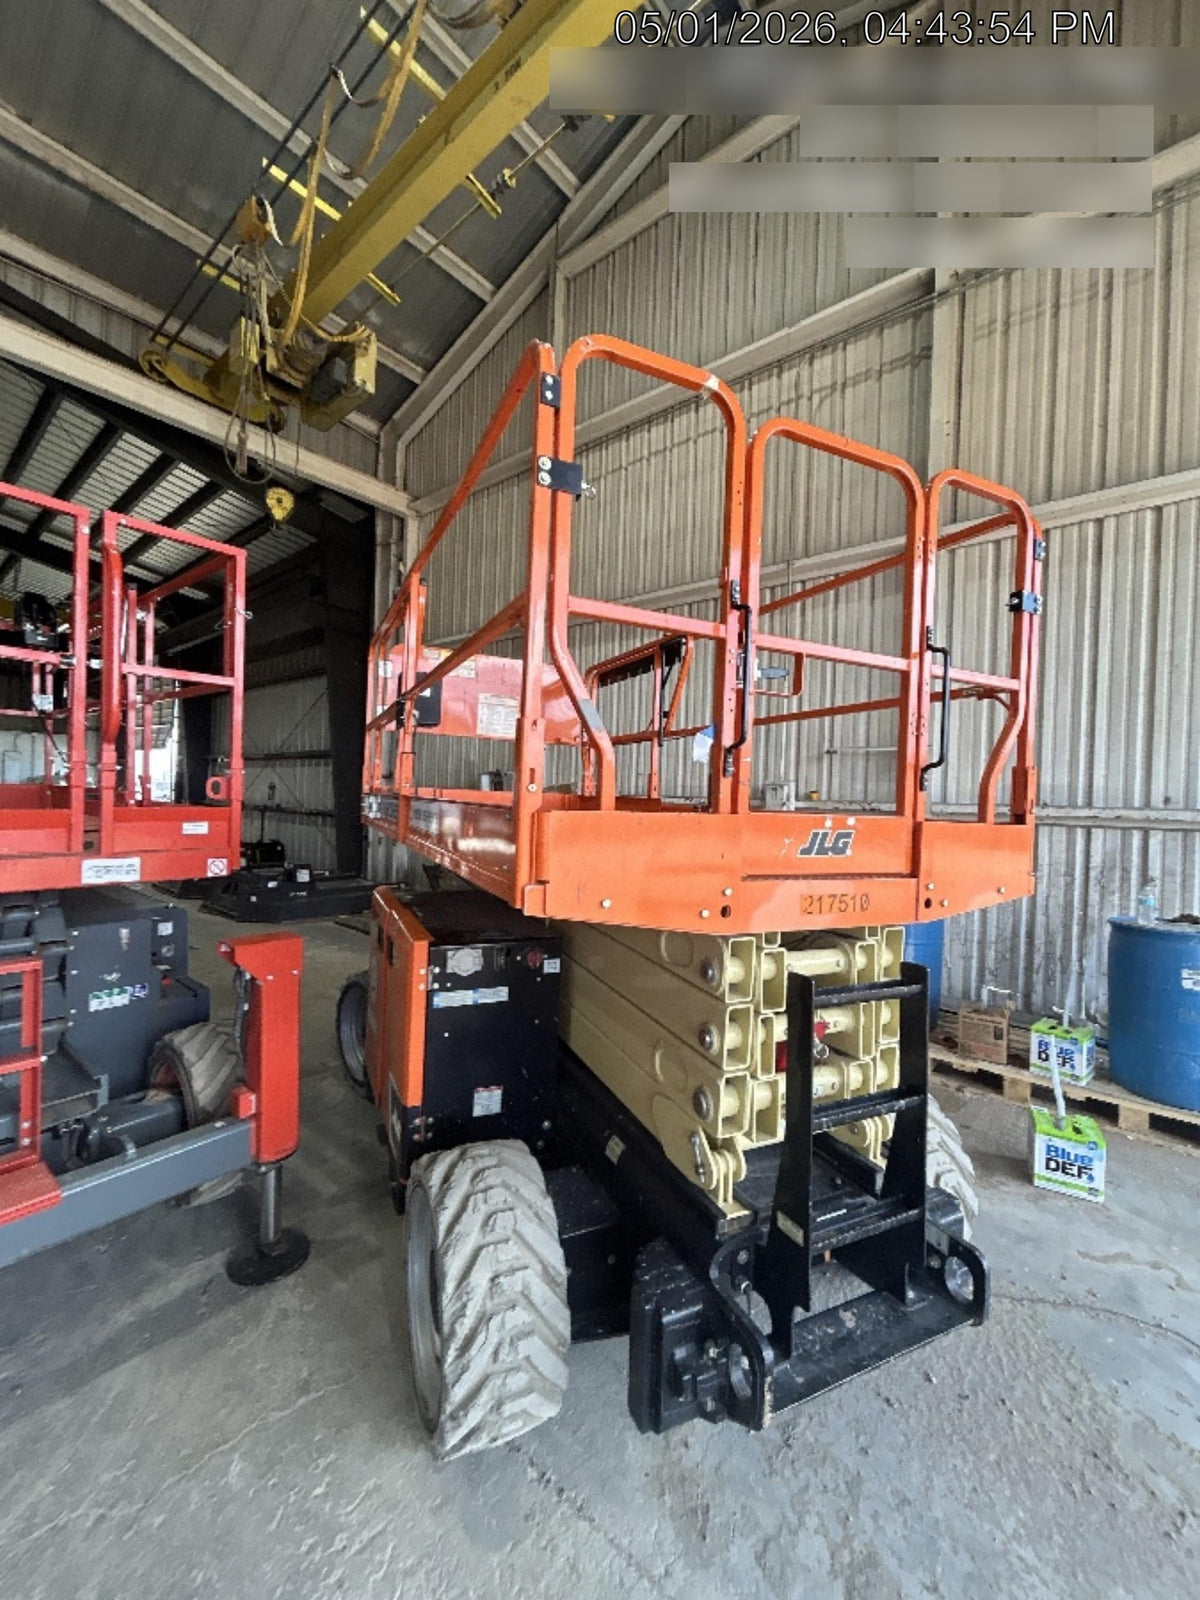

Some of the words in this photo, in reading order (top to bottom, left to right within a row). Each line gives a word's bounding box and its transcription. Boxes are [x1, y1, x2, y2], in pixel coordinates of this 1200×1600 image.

[796, 829, 856, 858] JLG
[802, 893, 870, 915] 217510
[1045, 1156, 1094, 1179] DEF
